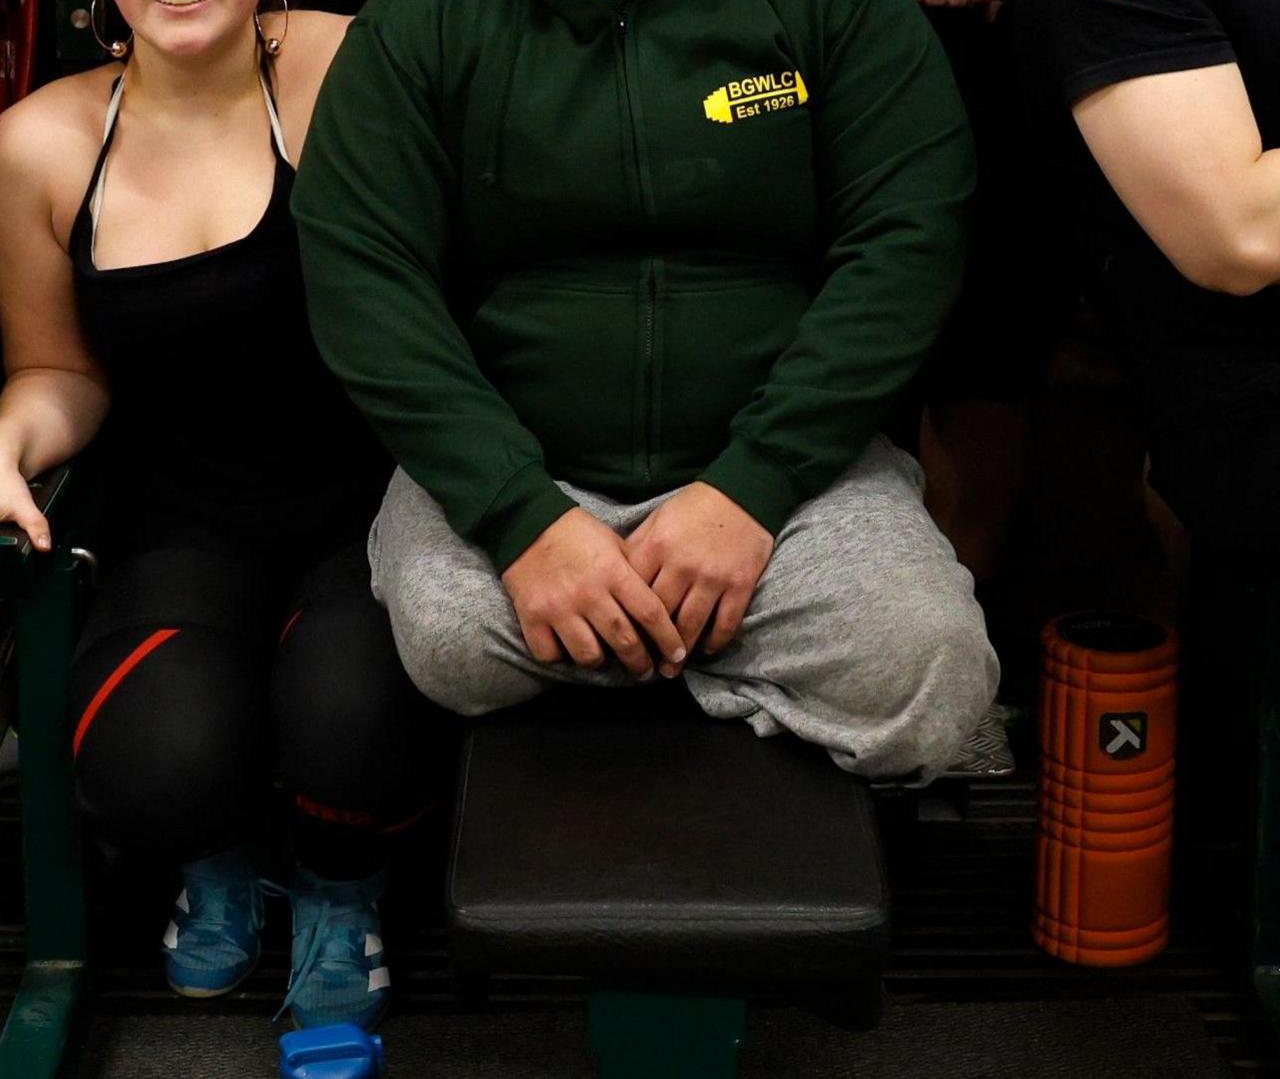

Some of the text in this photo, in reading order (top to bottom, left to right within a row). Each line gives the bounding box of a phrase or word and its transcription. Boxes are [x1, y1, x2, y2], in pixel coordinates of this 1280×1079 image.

[728, 71, 794, 99] BGWLC
[736, 95, 795, 120] Est 1926
